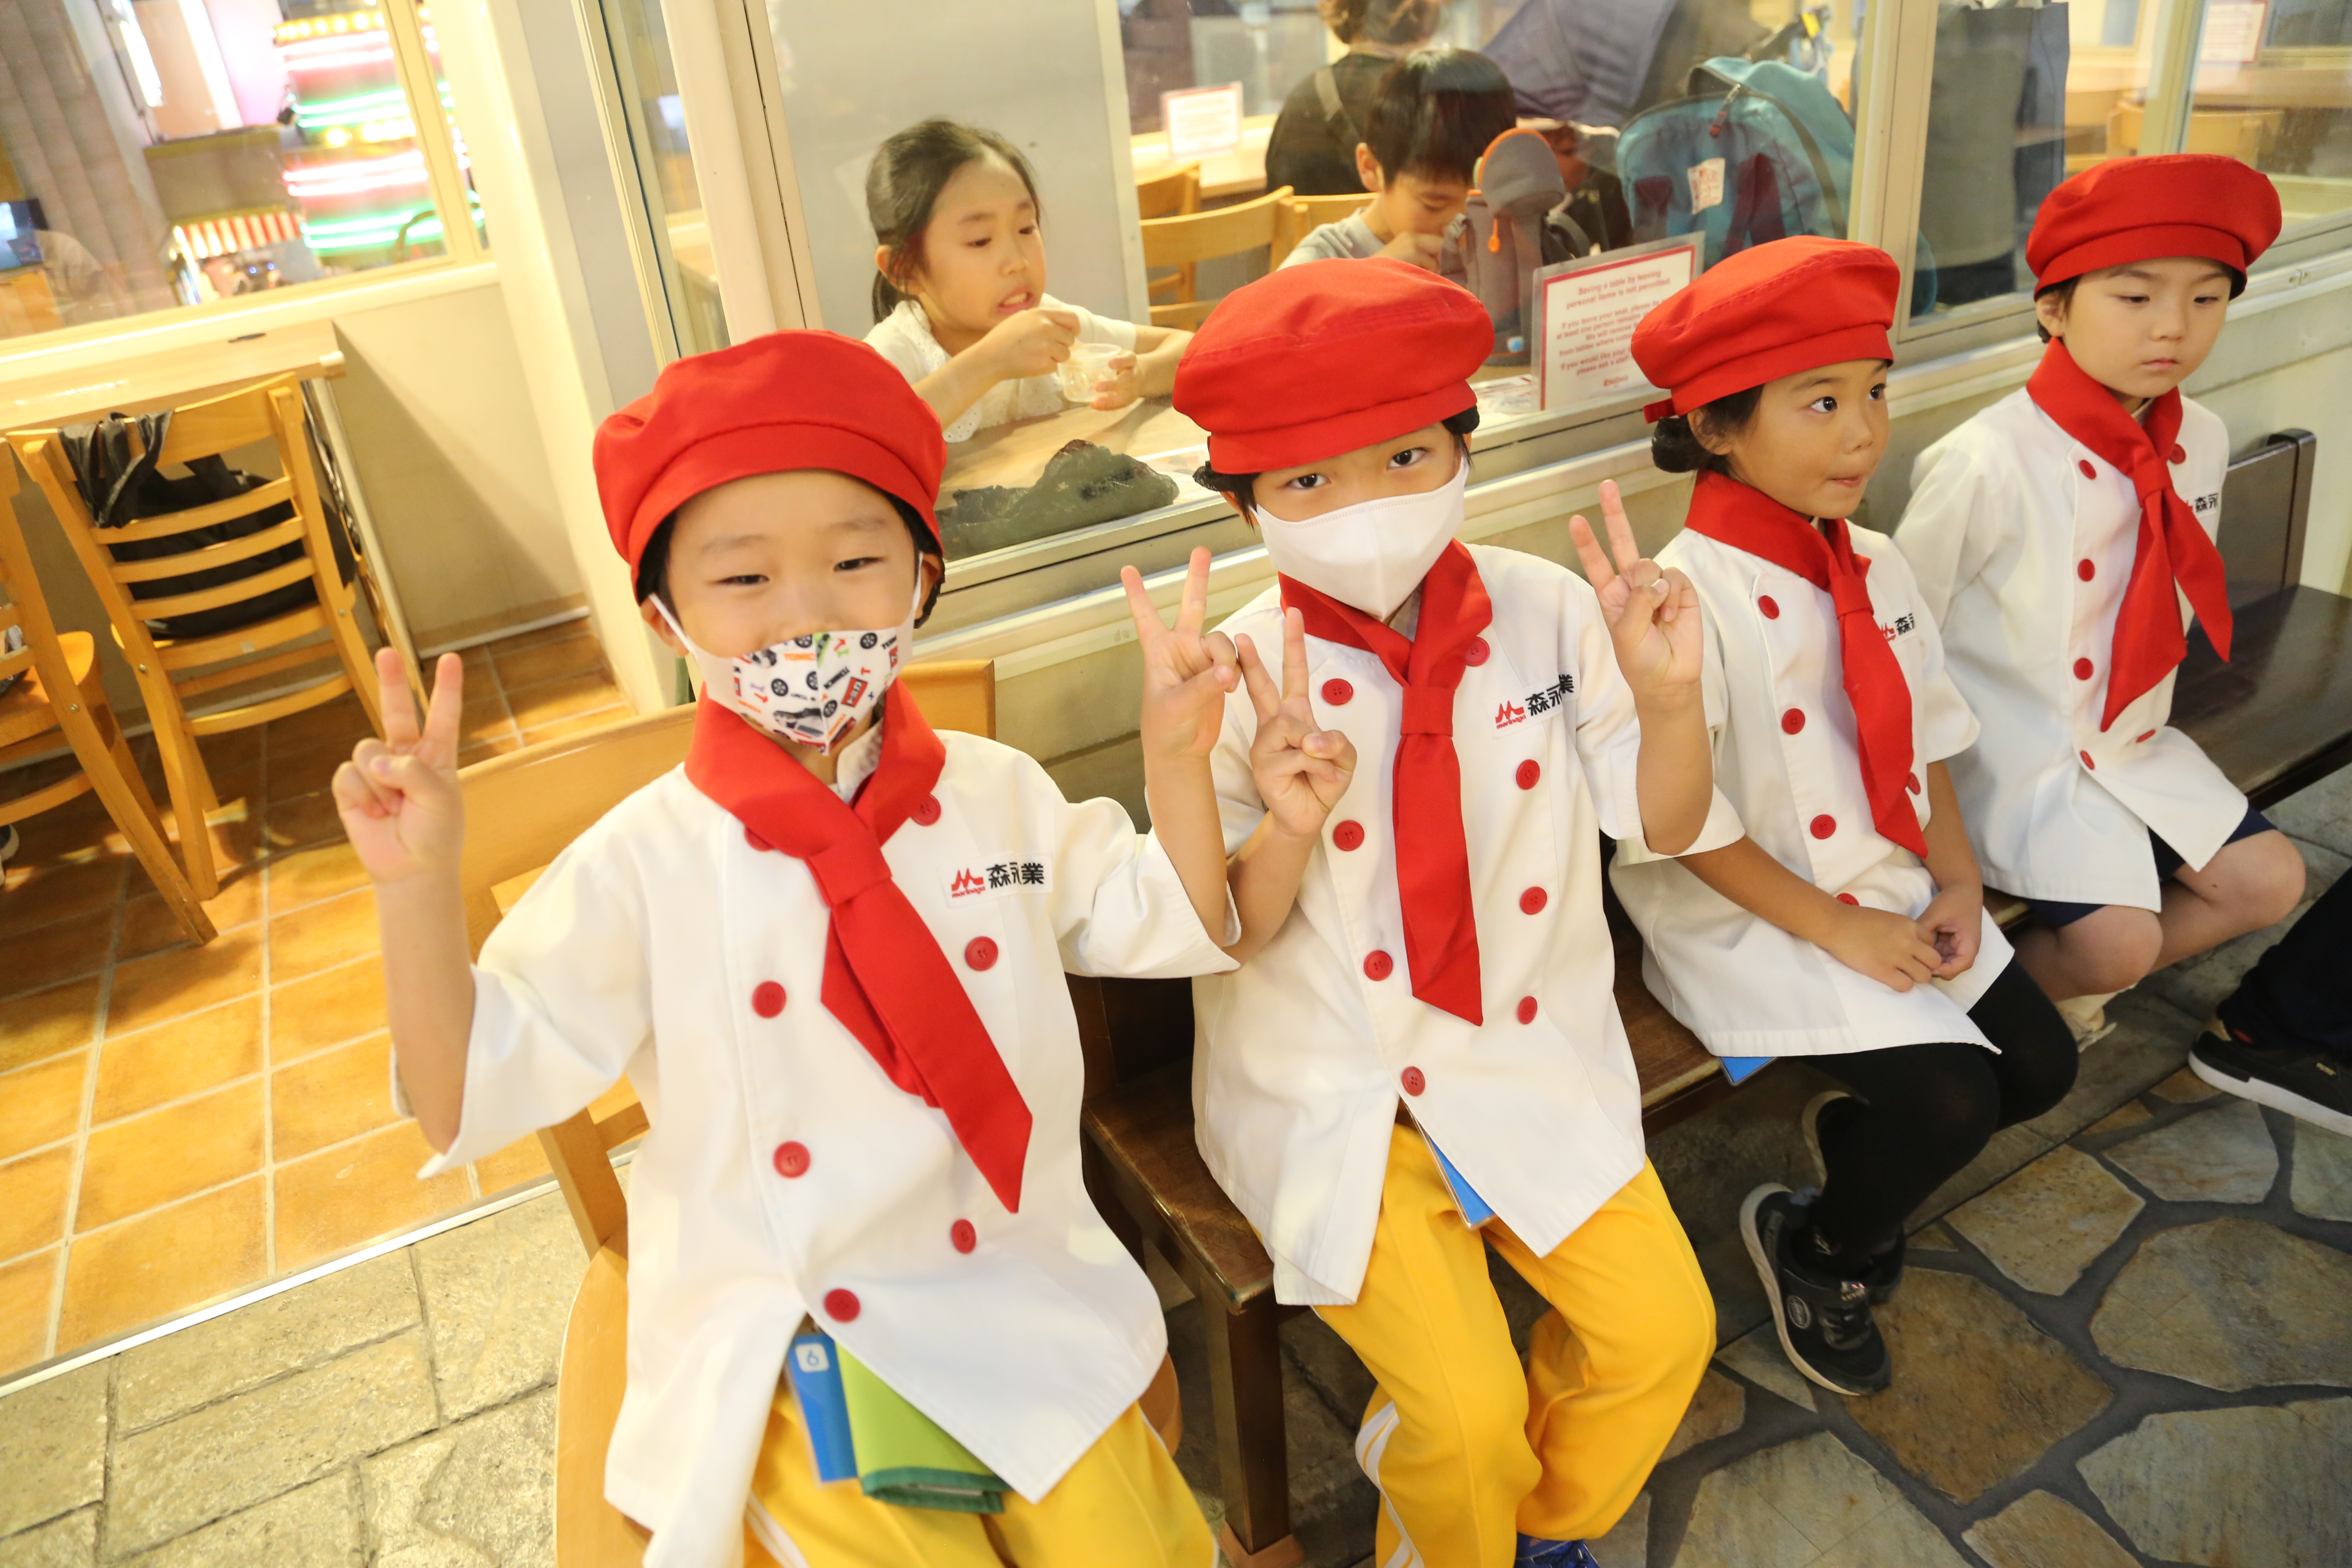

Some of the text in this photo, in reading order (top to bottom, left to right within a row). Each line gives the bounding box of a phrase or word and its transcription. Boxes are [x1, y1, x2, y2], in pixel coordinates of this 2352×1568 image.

[1579, 285, 1602, 295] Saving
[1637, 271, 1662, 280] leaving
[1567, 296, 1596, 310] personal
[1525, 674, 1574, 717] 森永業
[986, 862, 1044, 889] 森永業
